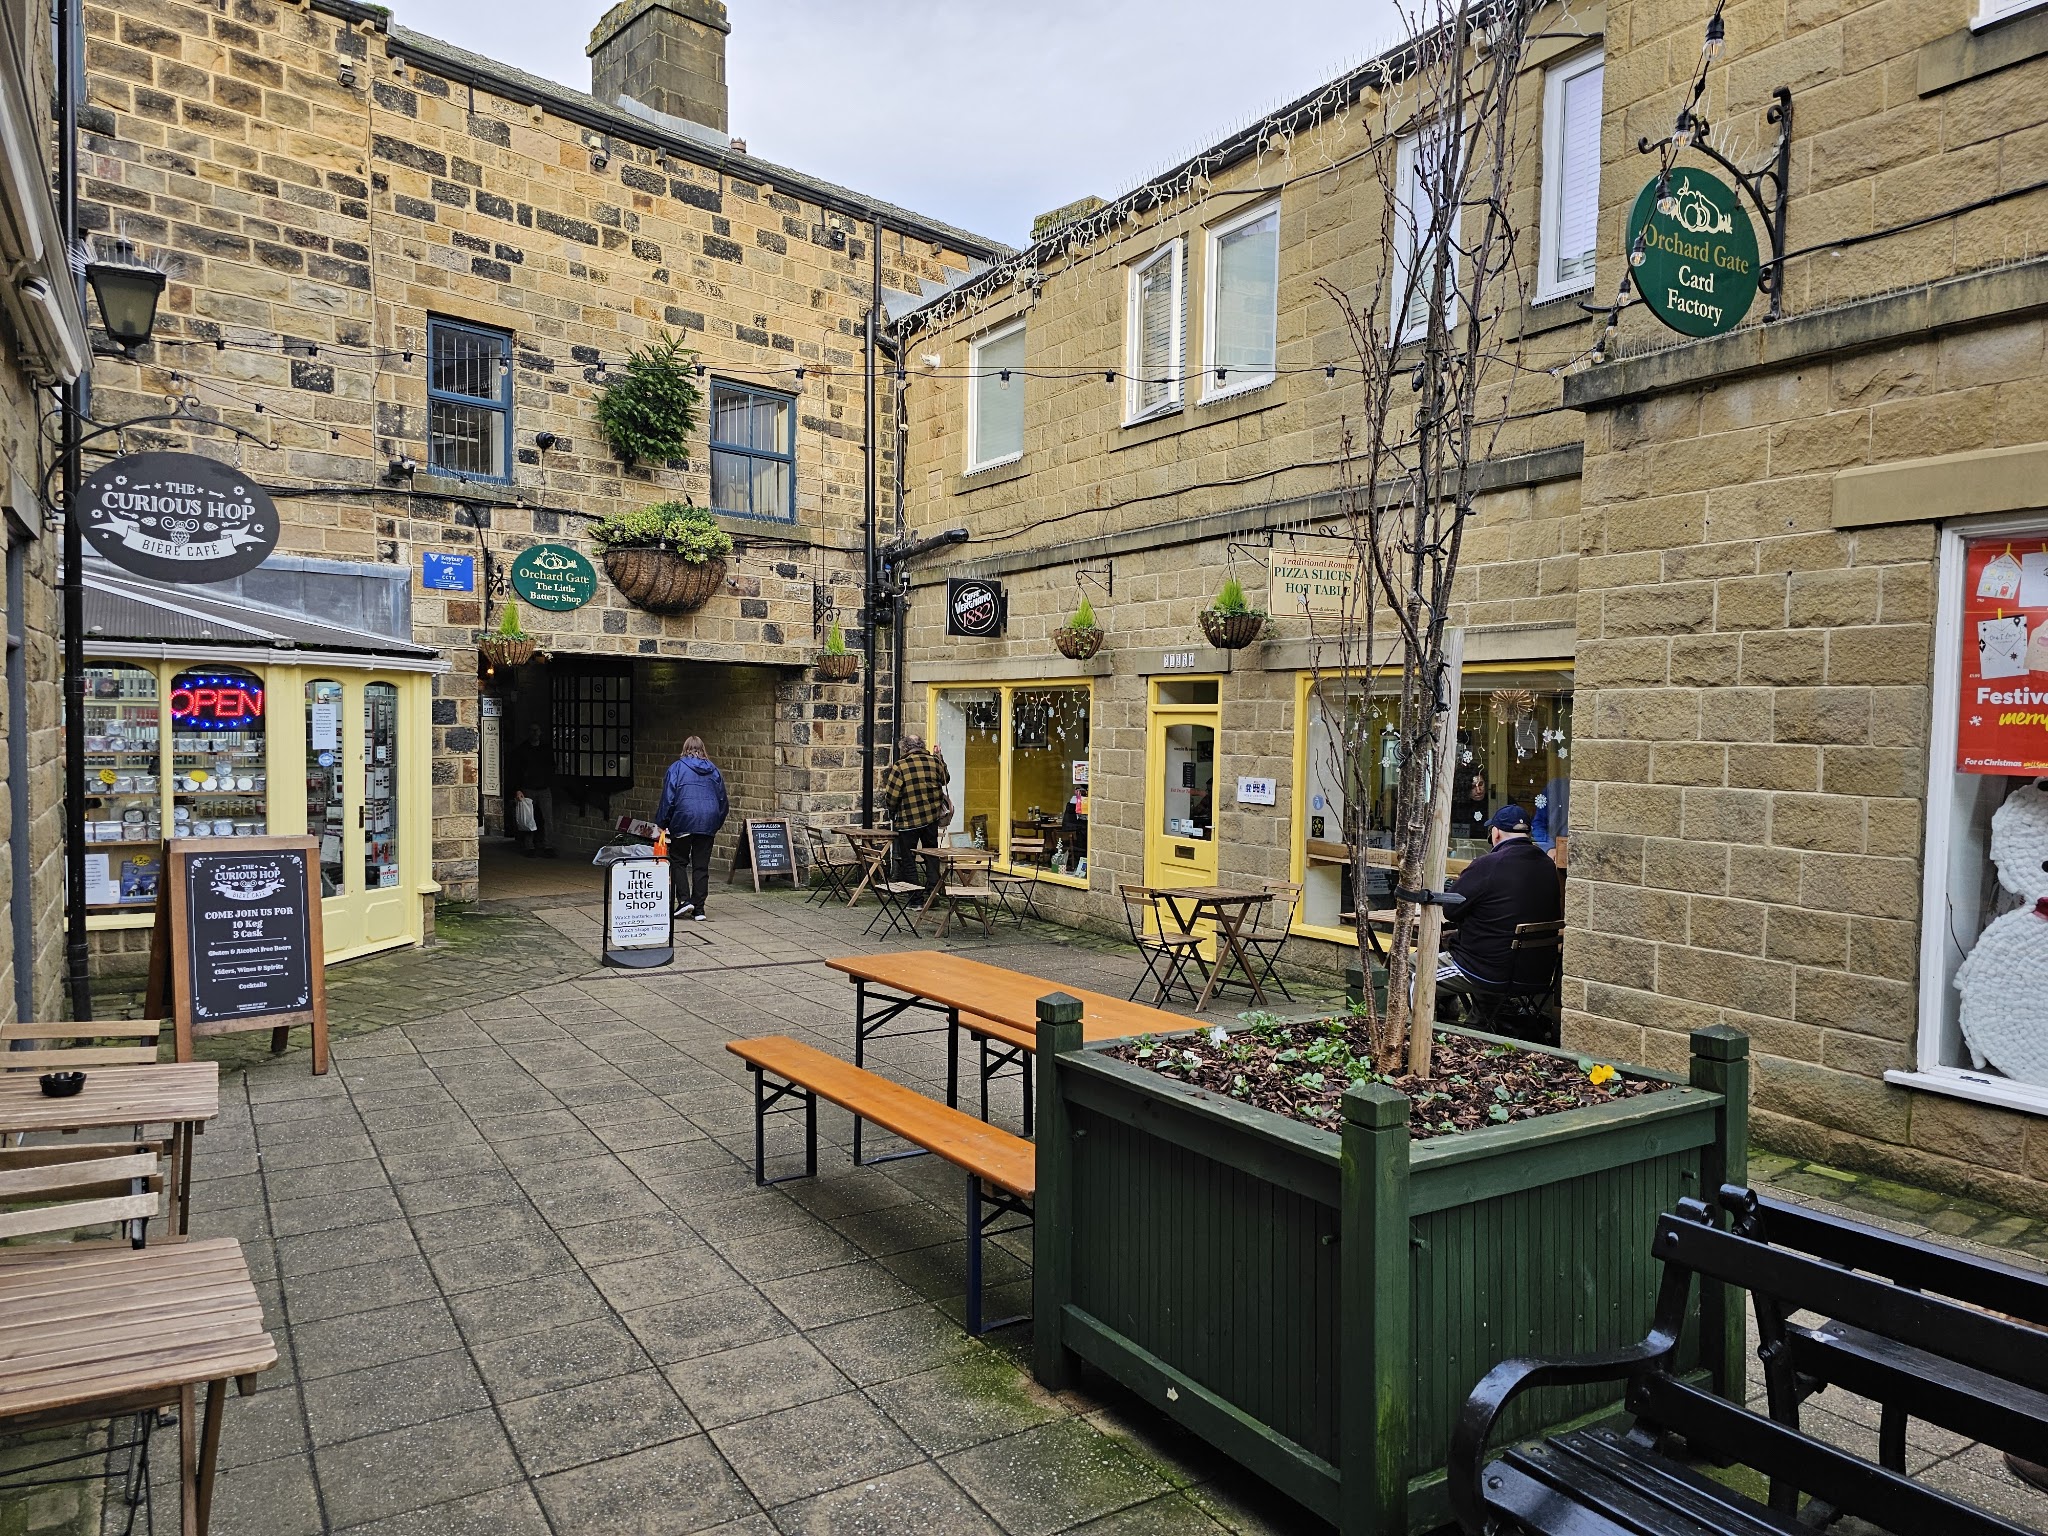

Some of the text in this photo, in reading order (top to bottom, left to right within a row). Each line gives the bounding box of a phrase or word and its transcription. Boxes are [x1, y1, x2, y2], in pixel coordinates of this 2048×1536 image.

[1644, 223, 1749, 275] Orchard Gate
[1679, 265, 1714, 293] Card
[1667, 288, 1722, 326] Factory
[166, 482, 195, 494] THE
[102, 492, 255, 520] CURIOUS HOP
[142, 540, 220, 556] BIÈRE CAFÉ
[441, 555, 464, 563] Keybury
[1283, 557, 1355, 569] Traditional Roman
[520, 568, 589, 584] Orchard Gate
[1274, 567, 1309, 579] PIZZA
[1312, 569, 1352, 581] SLICES
[536, 582, 576, 592] The Little
[1286, 583, 1351, 596] HOT TABLE
[530, 591, 581, 605] Battery Shop
[955, 592, 991, 614] VERGNANO
[963, 603, 990, 627] 1882
[169, 689, 263, 717] OPEN
[215, 870, 280, 881] CURIOUS HOP
[629, 870, 652, 879] The
[628, 880, 654, 889] little
[619, 890, 662, 900] battery
[626, 901, 656, 910] shop
[205, 907, 293, 920] COME JOIN US FOR
[246, 920, 263, 928] Keg
[233, 929, 263, 938] 3 Cask
